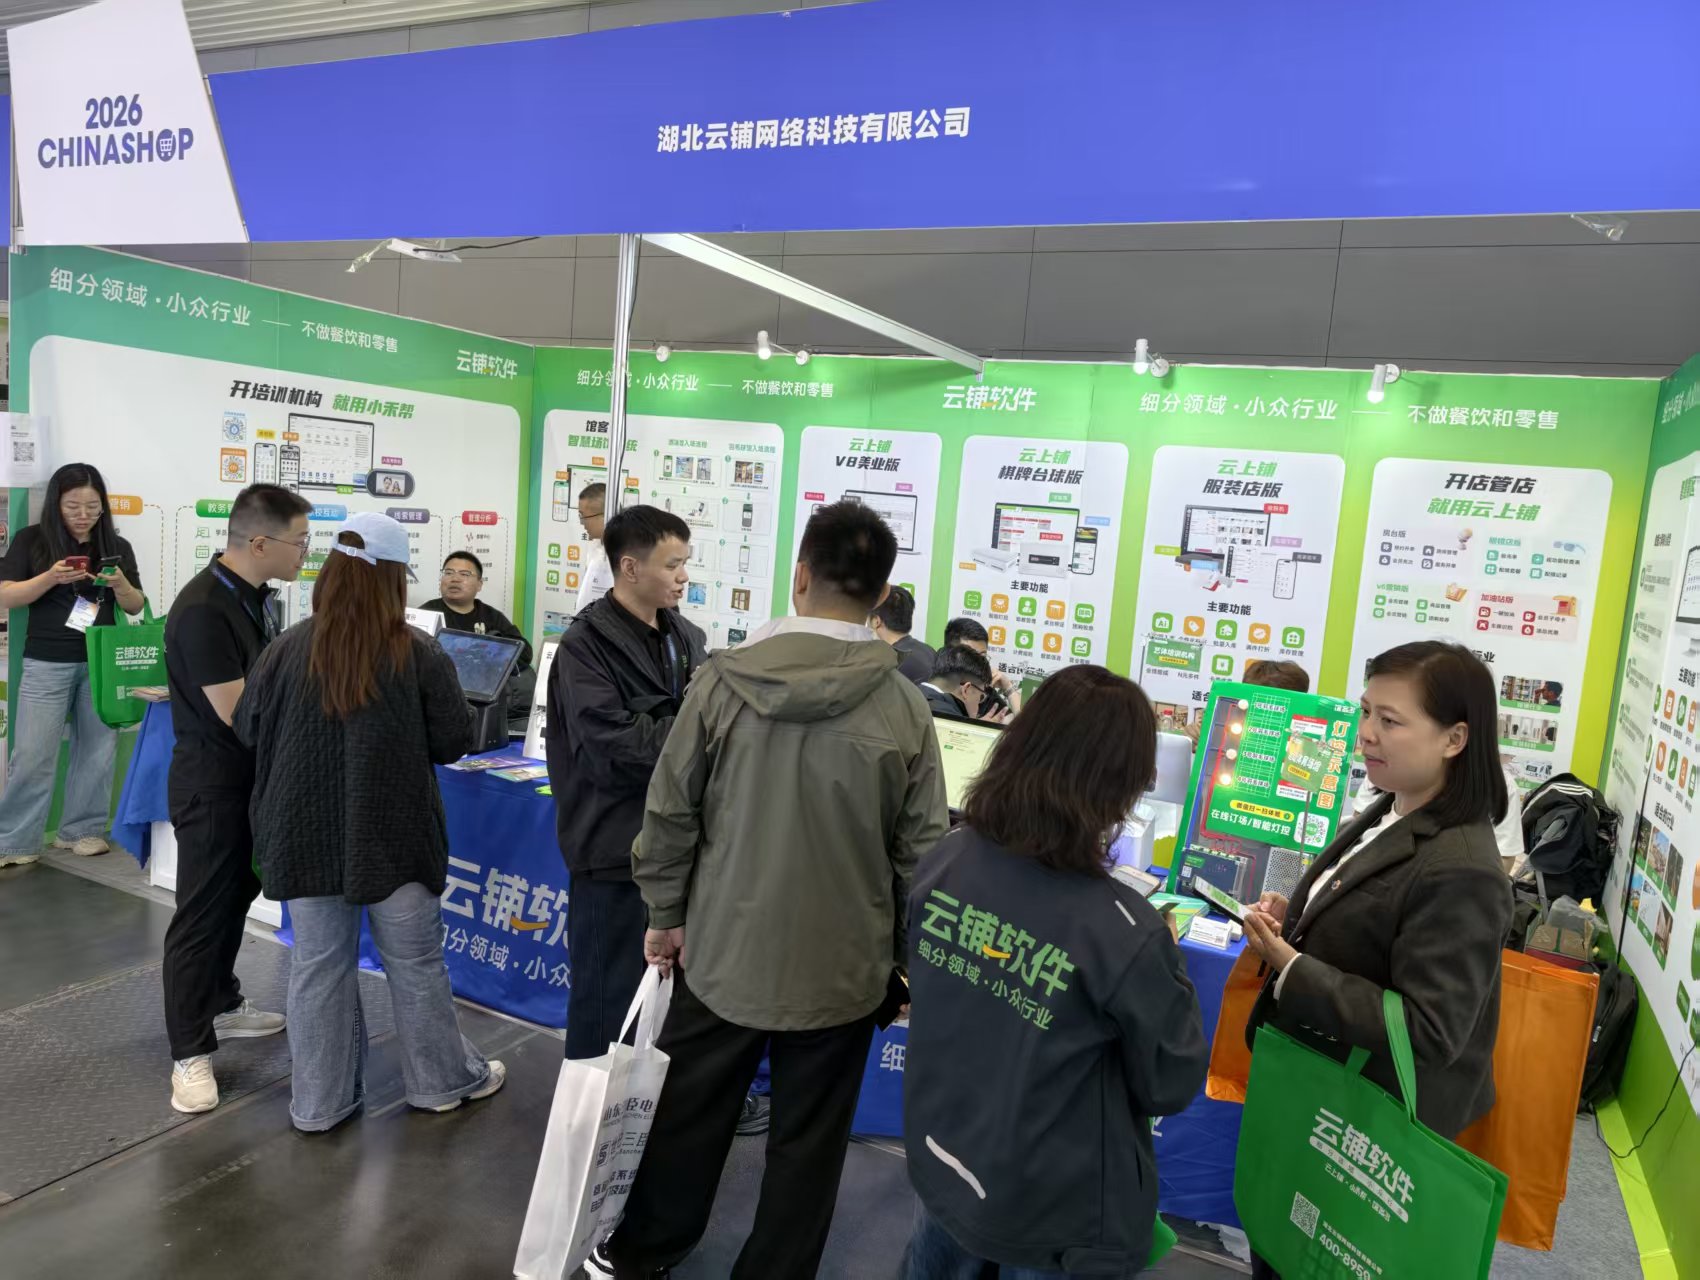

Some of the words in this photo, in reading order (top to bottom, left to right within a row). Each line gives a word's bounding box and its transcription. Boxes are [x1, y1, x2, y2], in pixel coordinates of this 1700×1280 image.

[85, 94, 143, 129] 2026
[657, 107, 970, 152] 湖北云铺网络科技有限公司
[37, 127, 194, 169] CHINASHOP
[49, 266, 252, 327] 细分领域·小众行业
[301, 320, 398, 353] 不做餐饮和零售
[456, 350, 518, 380] 云铺软件
[230, 379, 323, 408] 开培训机构
[332, 393, 415, 419] 就用小禾帮
[742, 379, 833, 398] 不做餐饮和零售
[943, 385, 1038, 412] 云铺软件
[1139, 393, 1338, 421] 细分领域·小众行业
[1407, 404, 1559, 430] 不做餐饮和零售
[568, 434, 638, 452] 智慧场统
[848, 437, 893, 454] 云上铺
[835, 455, 901, 472] V8美业版
[1018, 448, 1071, 465] 云上铺
[1217, 459, 1277, 478] 云上铺
[997, 466, 1084, 485] 棋牌台球版
[1444, 473, 1537, 495] 开店管店
[1202, 478, 1283, 499] 服装店版
[1427, 497, 1541, 521] 就用云上铺
[1010, 580, 1049, 594] 主要功能
[1207, 601, 1252, 616] 主要功能
[115, 646, 159, 660] 云铺软件
[1211, 809, 1291, 836] 在线订场/智能灯控
[921, 889, 1075, 996] 云铺软件
[917, 938, 1053, 1030] 细分领域·小众行业
[1312, 1107, 1415, 1204] 云铺软件
